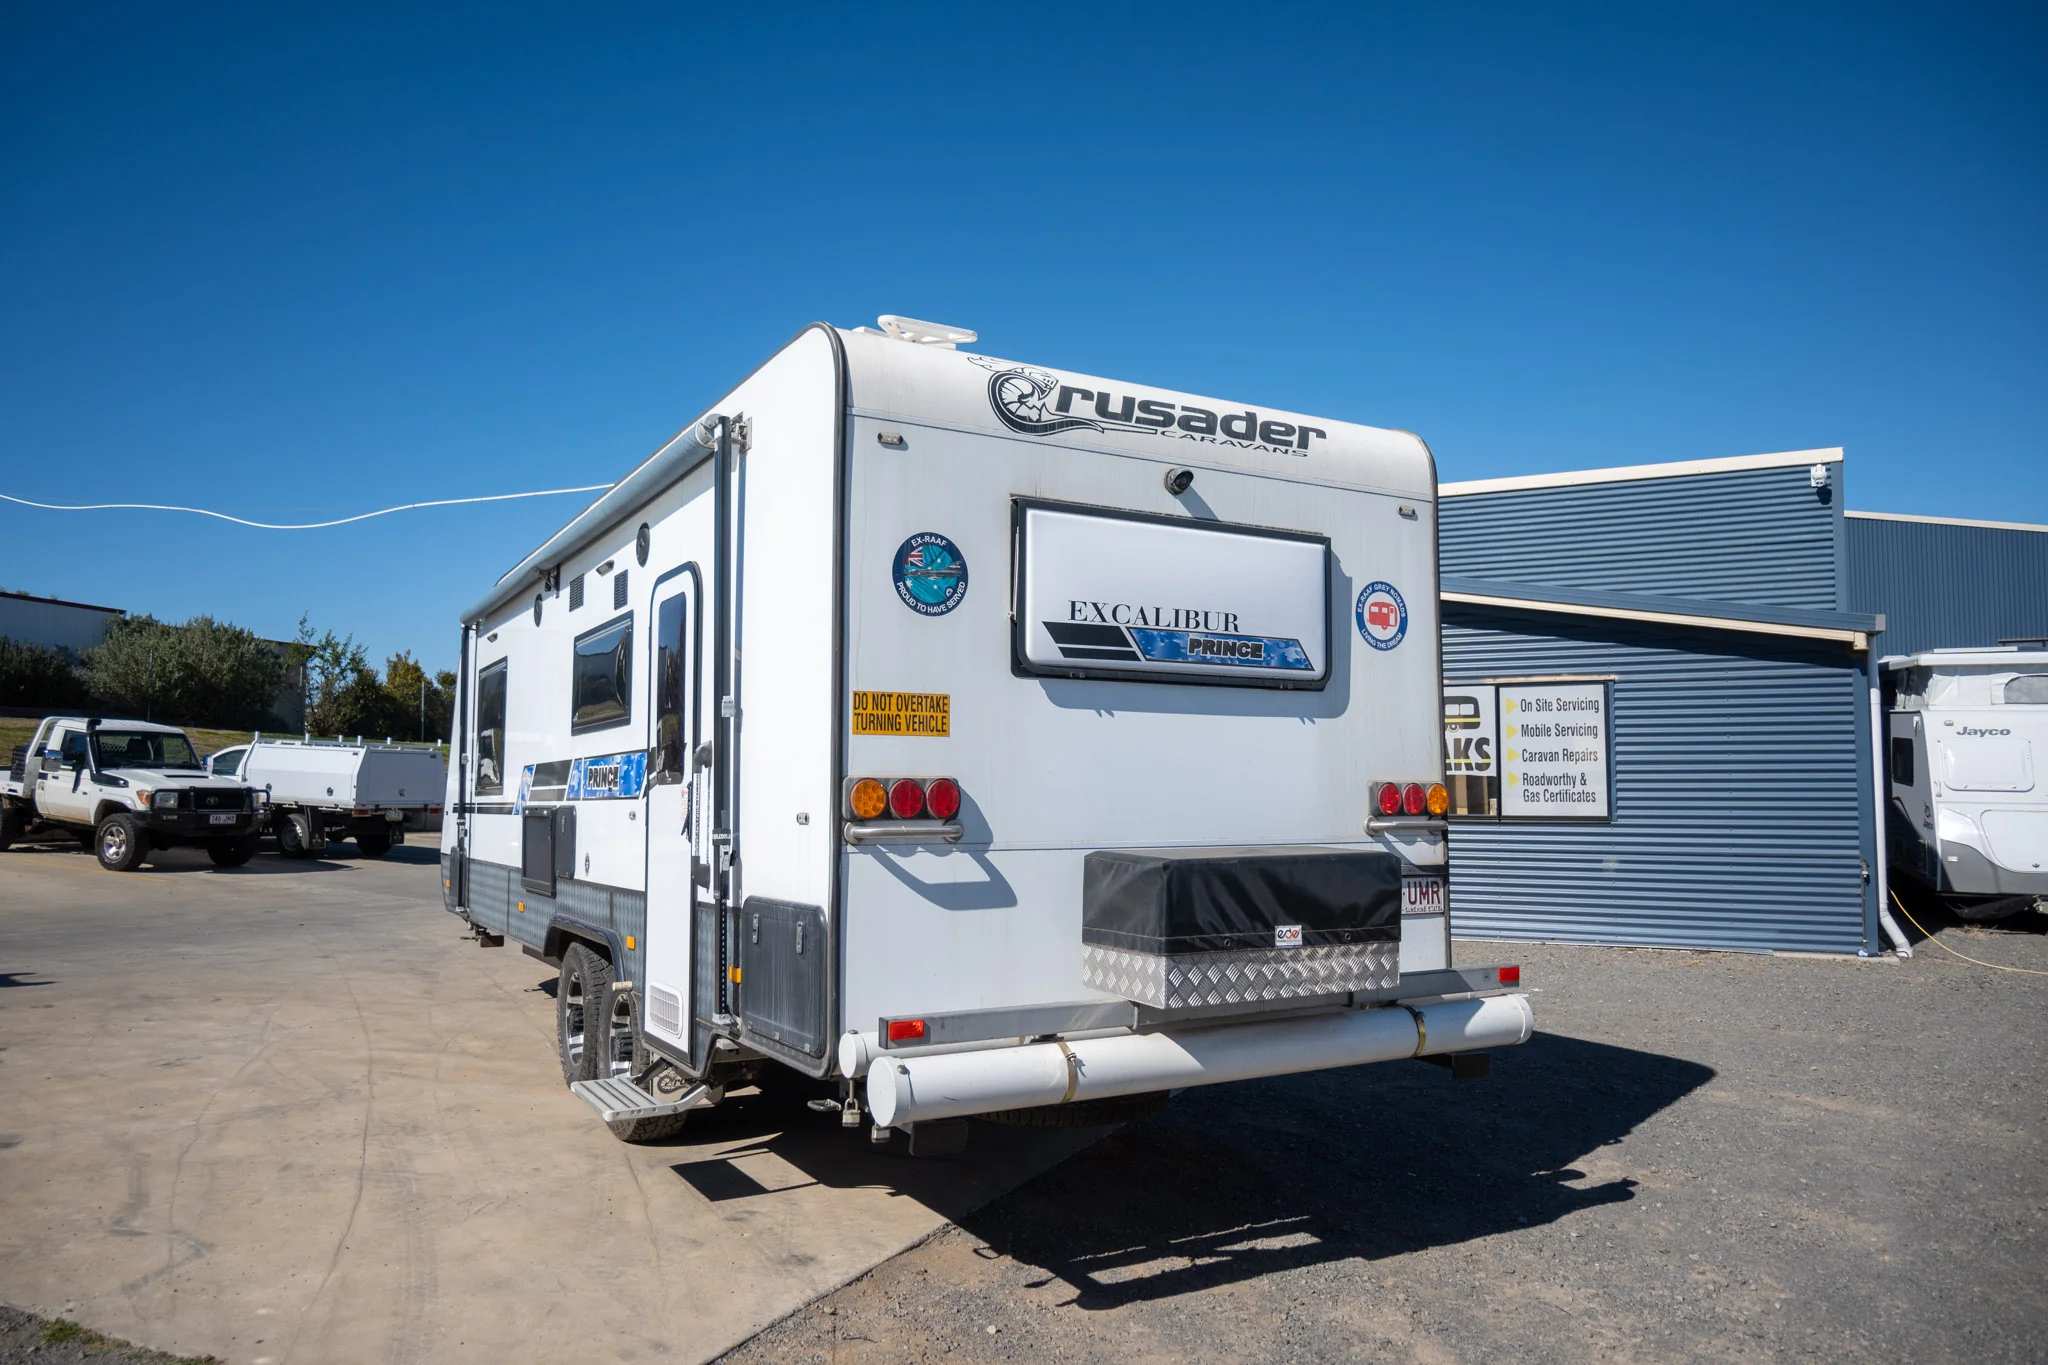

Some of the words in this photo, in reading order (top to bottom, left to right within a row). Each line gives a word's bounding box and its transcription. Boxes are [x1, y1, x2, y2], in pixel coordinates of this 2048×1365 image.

[1159, 430, 1308, 458] CARAVANS
[911, 535, 948, 547] EX-RAAF
[897, 581, 916, 607] PROUD
[917, 603, 927, 612] TO
[927, 603, 947, 614] HAVE
[946, 581, 966, 609] SERVED
[1068, 599, 1240, 634] EXCALIBUR
[1188, 637, 1265, 660] PRINCE
[1387, 632, 1403, 648] DREAM
[853, 692, 869, 711] DO
[872, 693, 893, 712] NOT
[896, 694, 948, 714] OVERTAKE
[1520, 699, 1533, 712] On
[1535, 698, 1553, 712] Site
[1556, 697, 1600, 713] Servicing
[854, 712, 902, 731] TURNING
[904, 714, 947, 733] VEHICLE
[1521, 723, 1552, 738] Mobile
[1555, 723, 1598, 739] Servicing
[1956, 726, 2011, 738] Jayco
[1522, 748, 1559, 762] Caravan
[1563, 748, 1598, 764] Repairs
[587, 765, 619, 790] PRINCE
[1522, 772, 1577, 788] Roadworthy
[1580, 773, 1587, 786] &
[1523, 789, 1541, 803] Gas
[1543, 789, 1596, 803] Certificates
[1407, 881, 1441, 905] UMR
